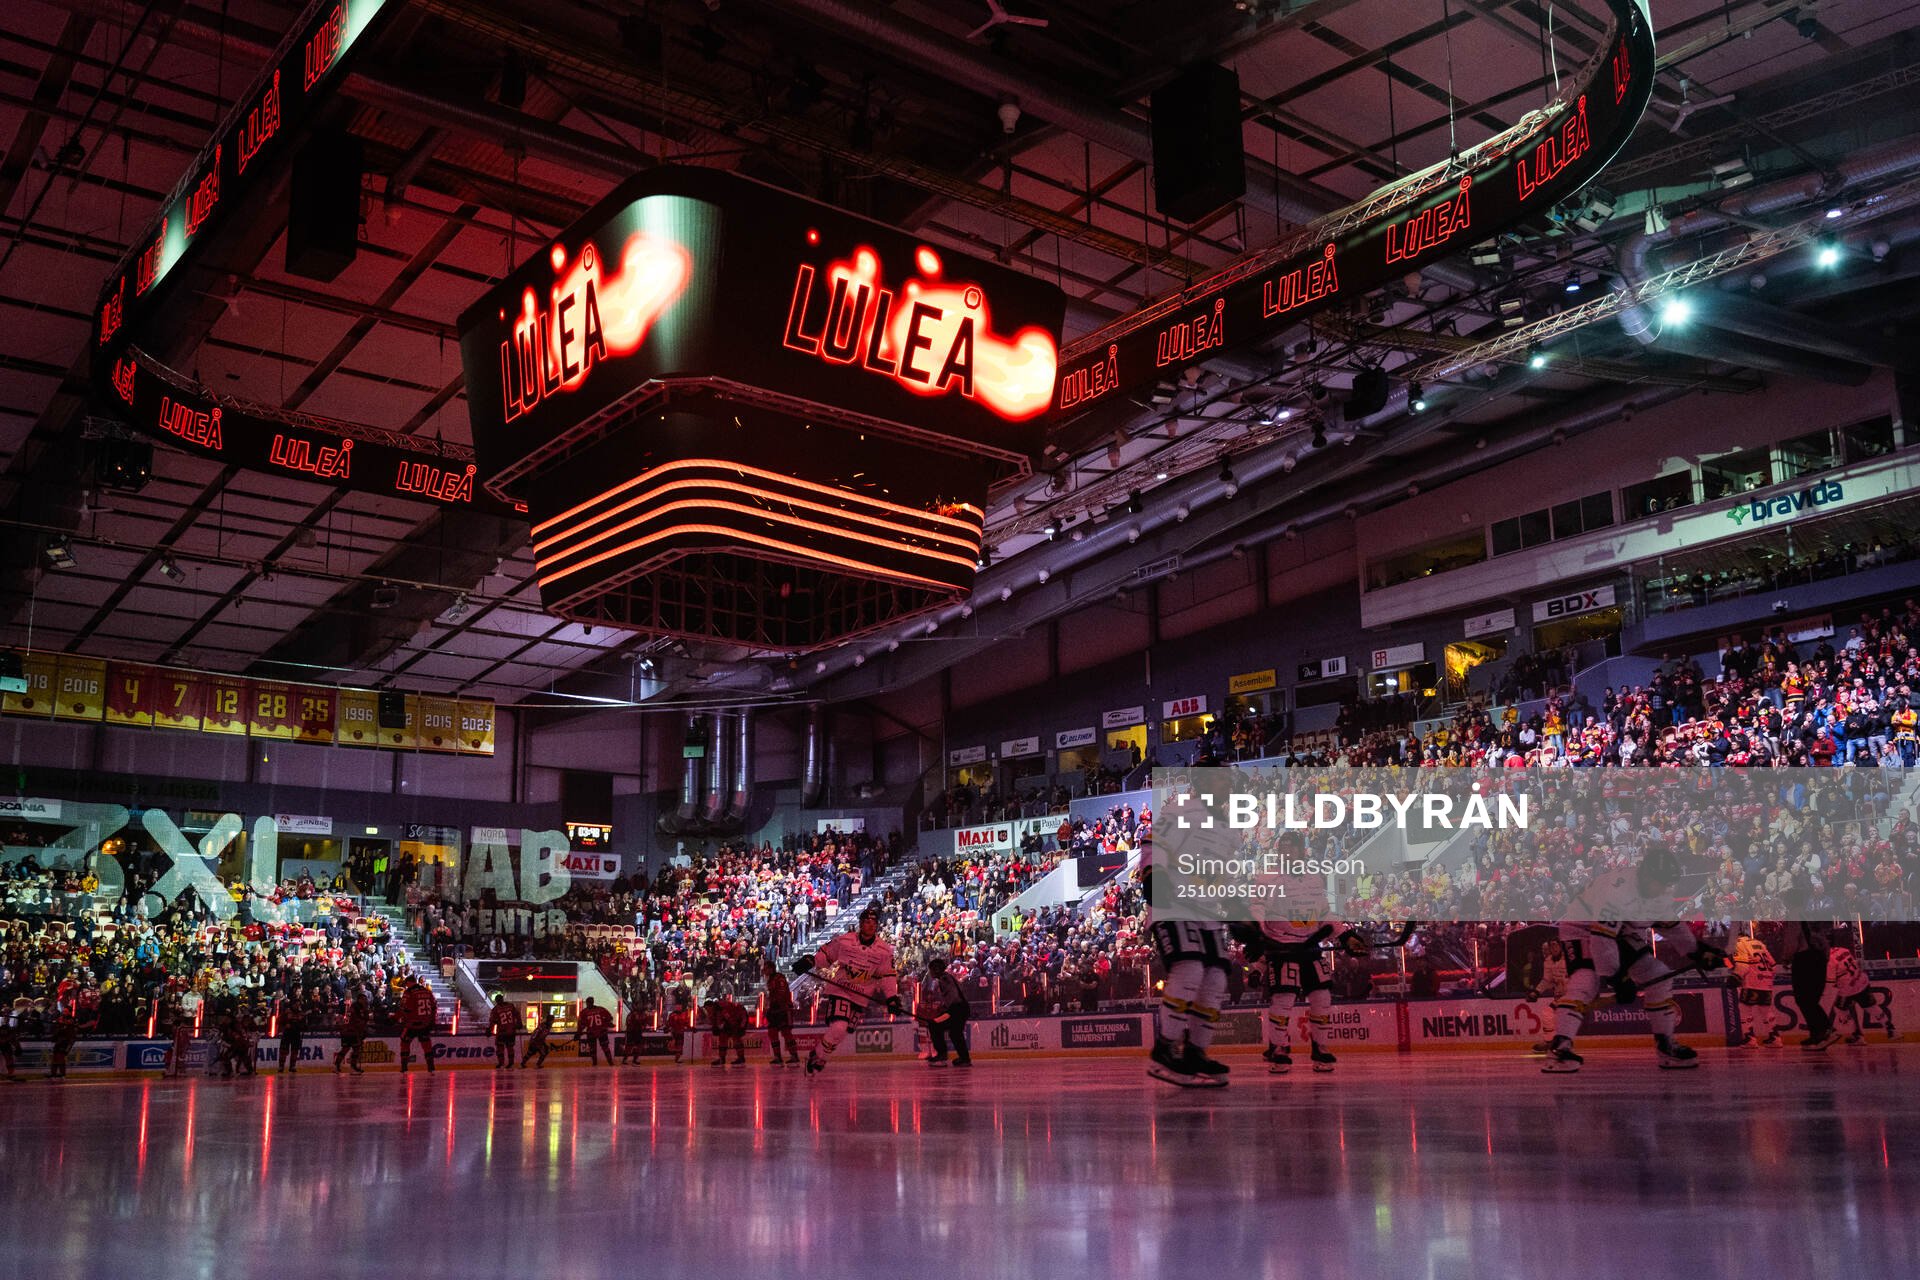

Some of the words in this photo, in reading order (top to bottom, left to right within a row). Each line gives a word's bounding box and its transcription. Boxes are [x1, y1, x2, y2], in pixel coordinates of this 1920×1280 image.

[1517, 95, 1590, 201] LULEÅ
[1385, 175, 1472, 264] LULEÅ
[1263, 243, 1338, 318] LULEÅ
[501, 243, 608, 424] LULEÅ
[783, 264, 982, 398] LULEÅ
[1156, 297, 1225, 367] LULEÅ
[1060, 343, 1118, 409] LULEÅ
[159, 396, 223, 450] LULEÅ
[269, 434, 354, 479] LULEÅ
[395, 461, 477, 503] LULEÅ
[1751, 479, 1844, 521] bravida
[1547, 590, 1600, 616] BDX
[24, 673, 48, 689] 018
[63, 677, 99, 695] 2016
[125, 678, 140, 704] 4
[1233, 675, 1272, 688] Assemblin
[173, 683, 189, 708] 7
[216, 688, 239, 715] 12
[258, 692, 287, 719] 28
[1171, 697, 1199, 716] ABB
[301, 697, 329, 722] 35
[344, 707, 374, 722] 1996
[425, 714, 452, 729] 2015
[462, 717, 492, 732] 2025
[958, 830, 995, 847] MAXI
[499, 1011, 513, 1025] 23
[587, 1014, 602, 1027] 76
[1071, 1023, 1093, 1034] LULEÅ
[1095, 1022, 1130, 1032] TEKNISKA
[1327, 1009, 1361, 1025] Luleå
[1422, 1015, 1480, 1038] NIEMI
[1482, 1014, 1514, 1036] BIL
[857, 1029, 891, 1049] coop
[1011, 1033, 1039, 1042] ALLBYGG
[1072, 1032, 1117, 1043] UNIVERSITET
[1327, 1027, 1370, 1041] Energi
